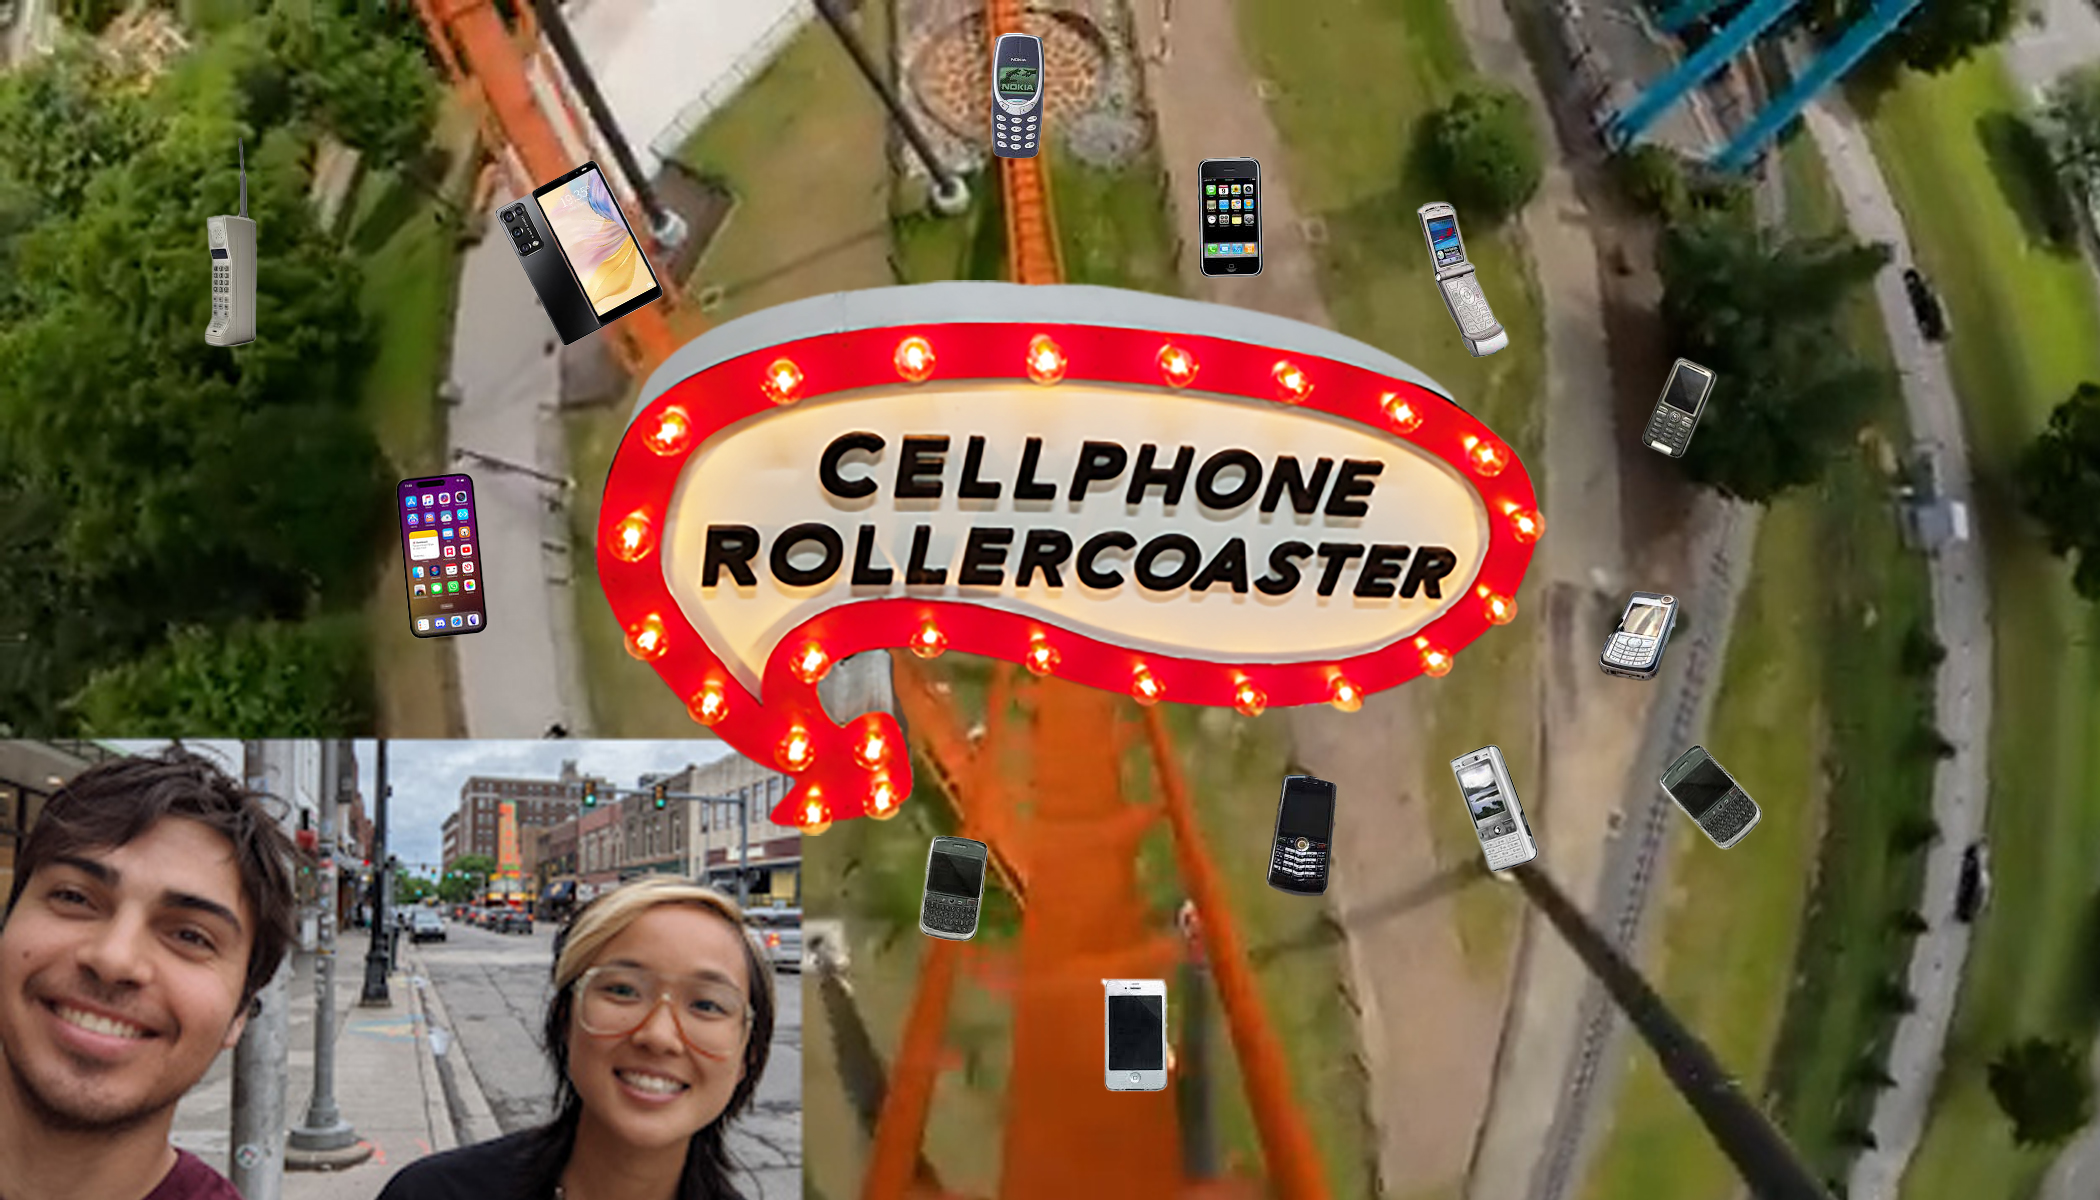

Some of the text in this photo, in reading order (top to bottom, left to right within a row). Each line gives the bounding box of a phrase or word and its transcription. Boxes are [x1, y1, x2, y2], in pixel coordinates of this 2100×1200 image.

[1001, 83, 1034, 91] NOKIA
[560, 186, 589, 209] 19:35
[819, 431, 1385, 517] CELLPHONE
[701, 522, 1458, 600] ROLLERCOASTER
